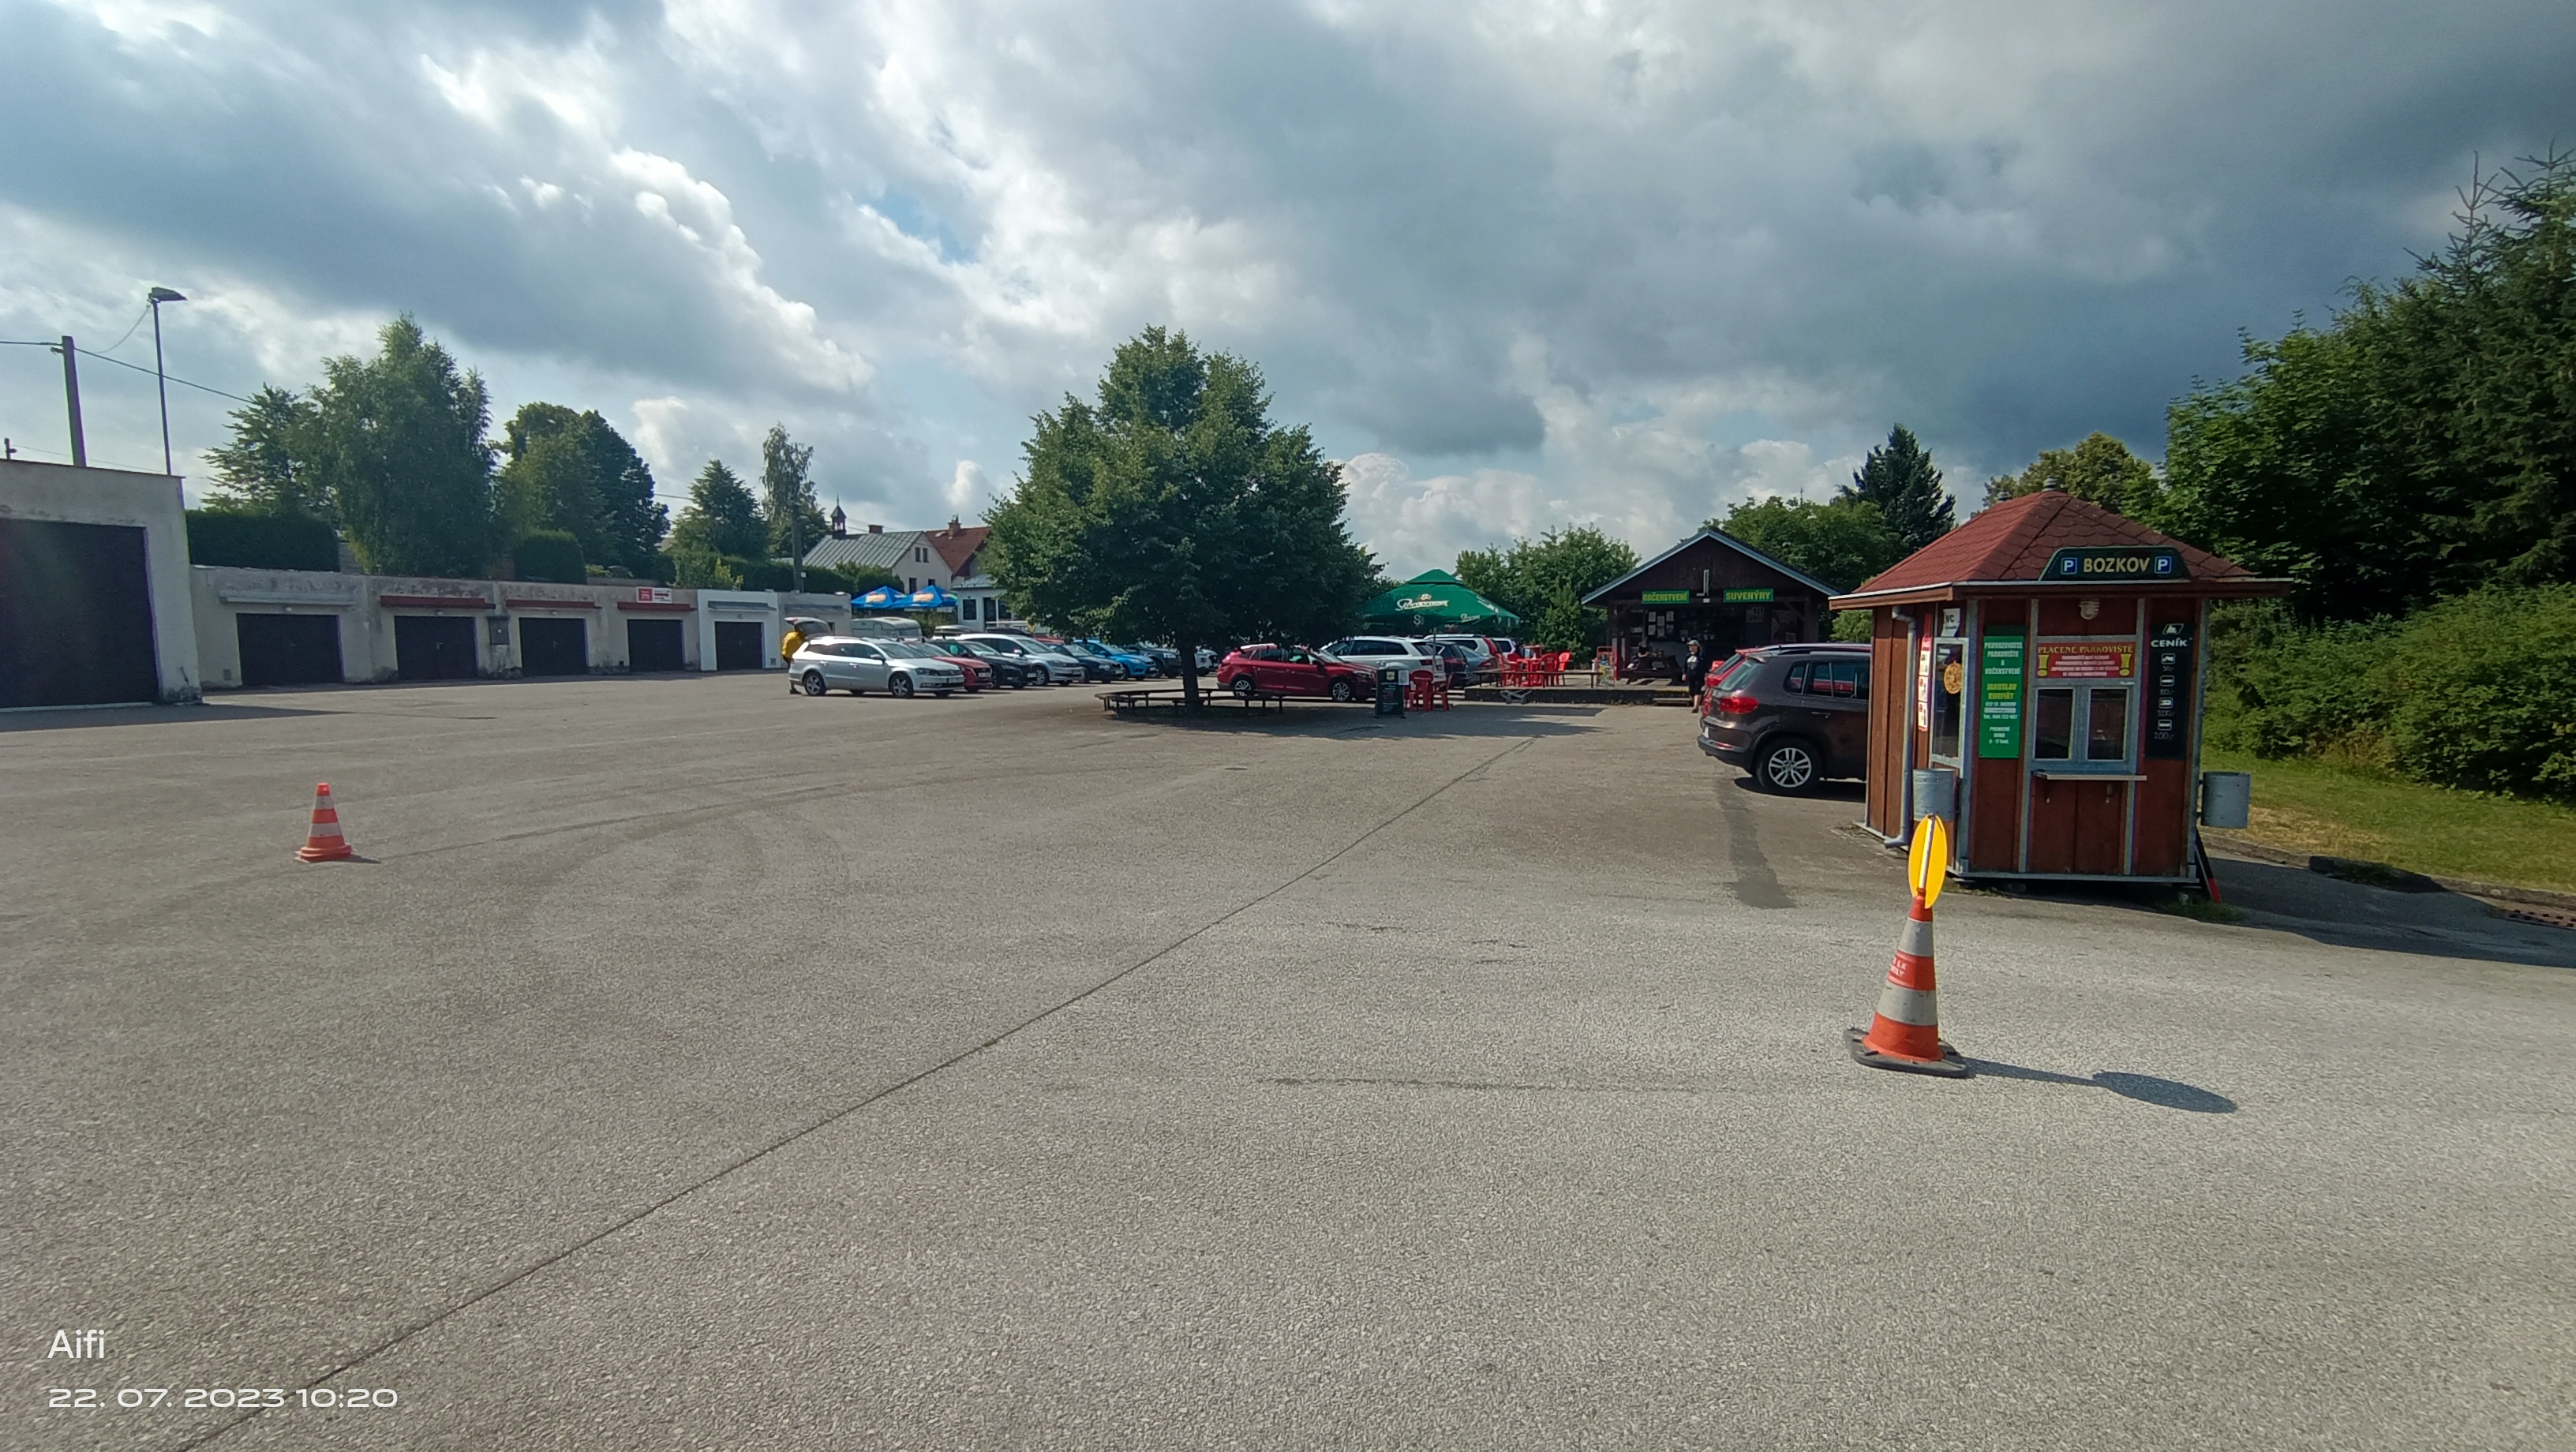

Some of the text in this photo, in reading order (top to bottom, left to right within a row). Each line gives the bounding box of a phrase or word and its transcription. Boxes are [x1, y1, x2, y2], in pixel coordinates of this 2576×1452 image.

[2083, 557, 2151, 573] BOZKOV
[1642, 591, 1687, 602] OBČERSTVENÍ
[1725, 589, 1771, 601] SUVENÝRY
[2151, 638, 2188, 648] CENÍK
[2038, 644, 2133, 654] PLACENÉ PARKOVIŠTĚ
